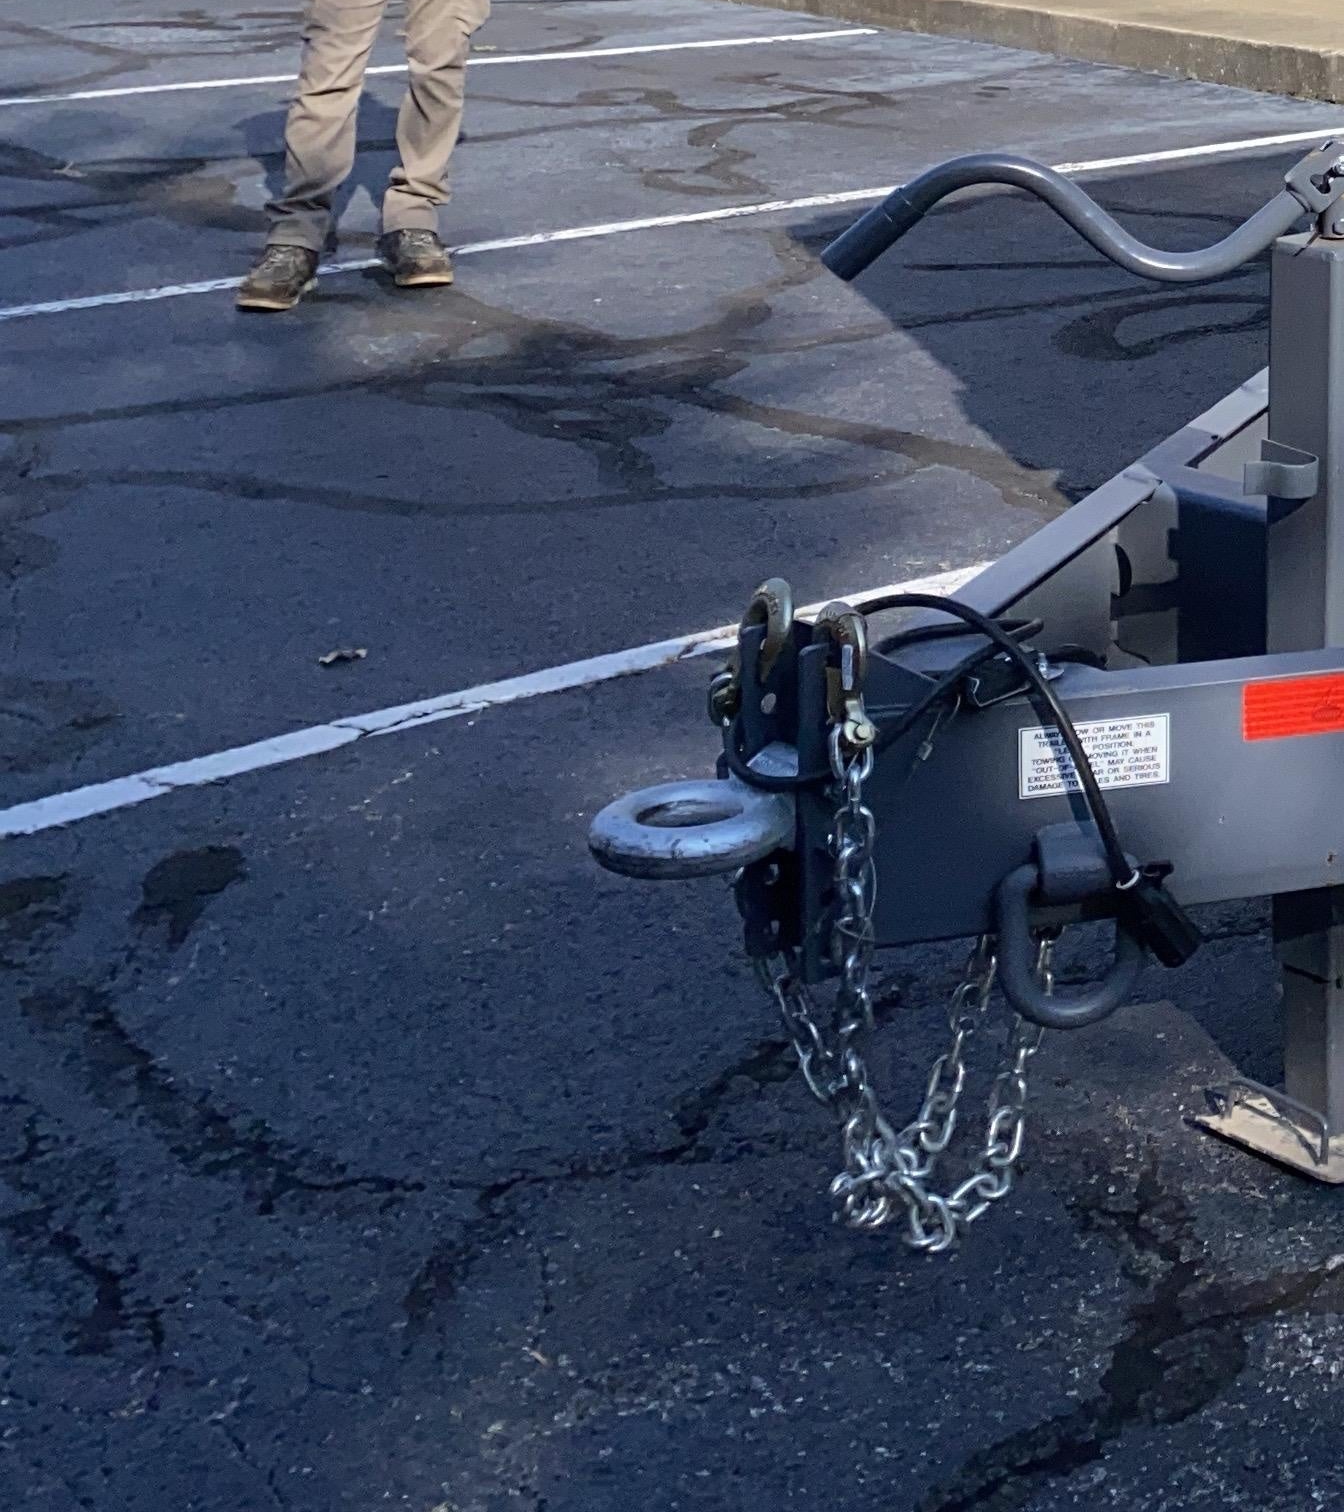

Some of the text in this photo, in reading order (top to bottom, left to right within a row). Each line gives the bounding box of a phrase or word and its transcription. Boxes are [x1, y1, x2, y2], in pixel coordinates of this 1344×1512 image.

[1101, 733, 1130, 741] FRAME
[1133, 746, 1158, 754] WHEN
[1128, 755, 1156, 763] CAUSE
